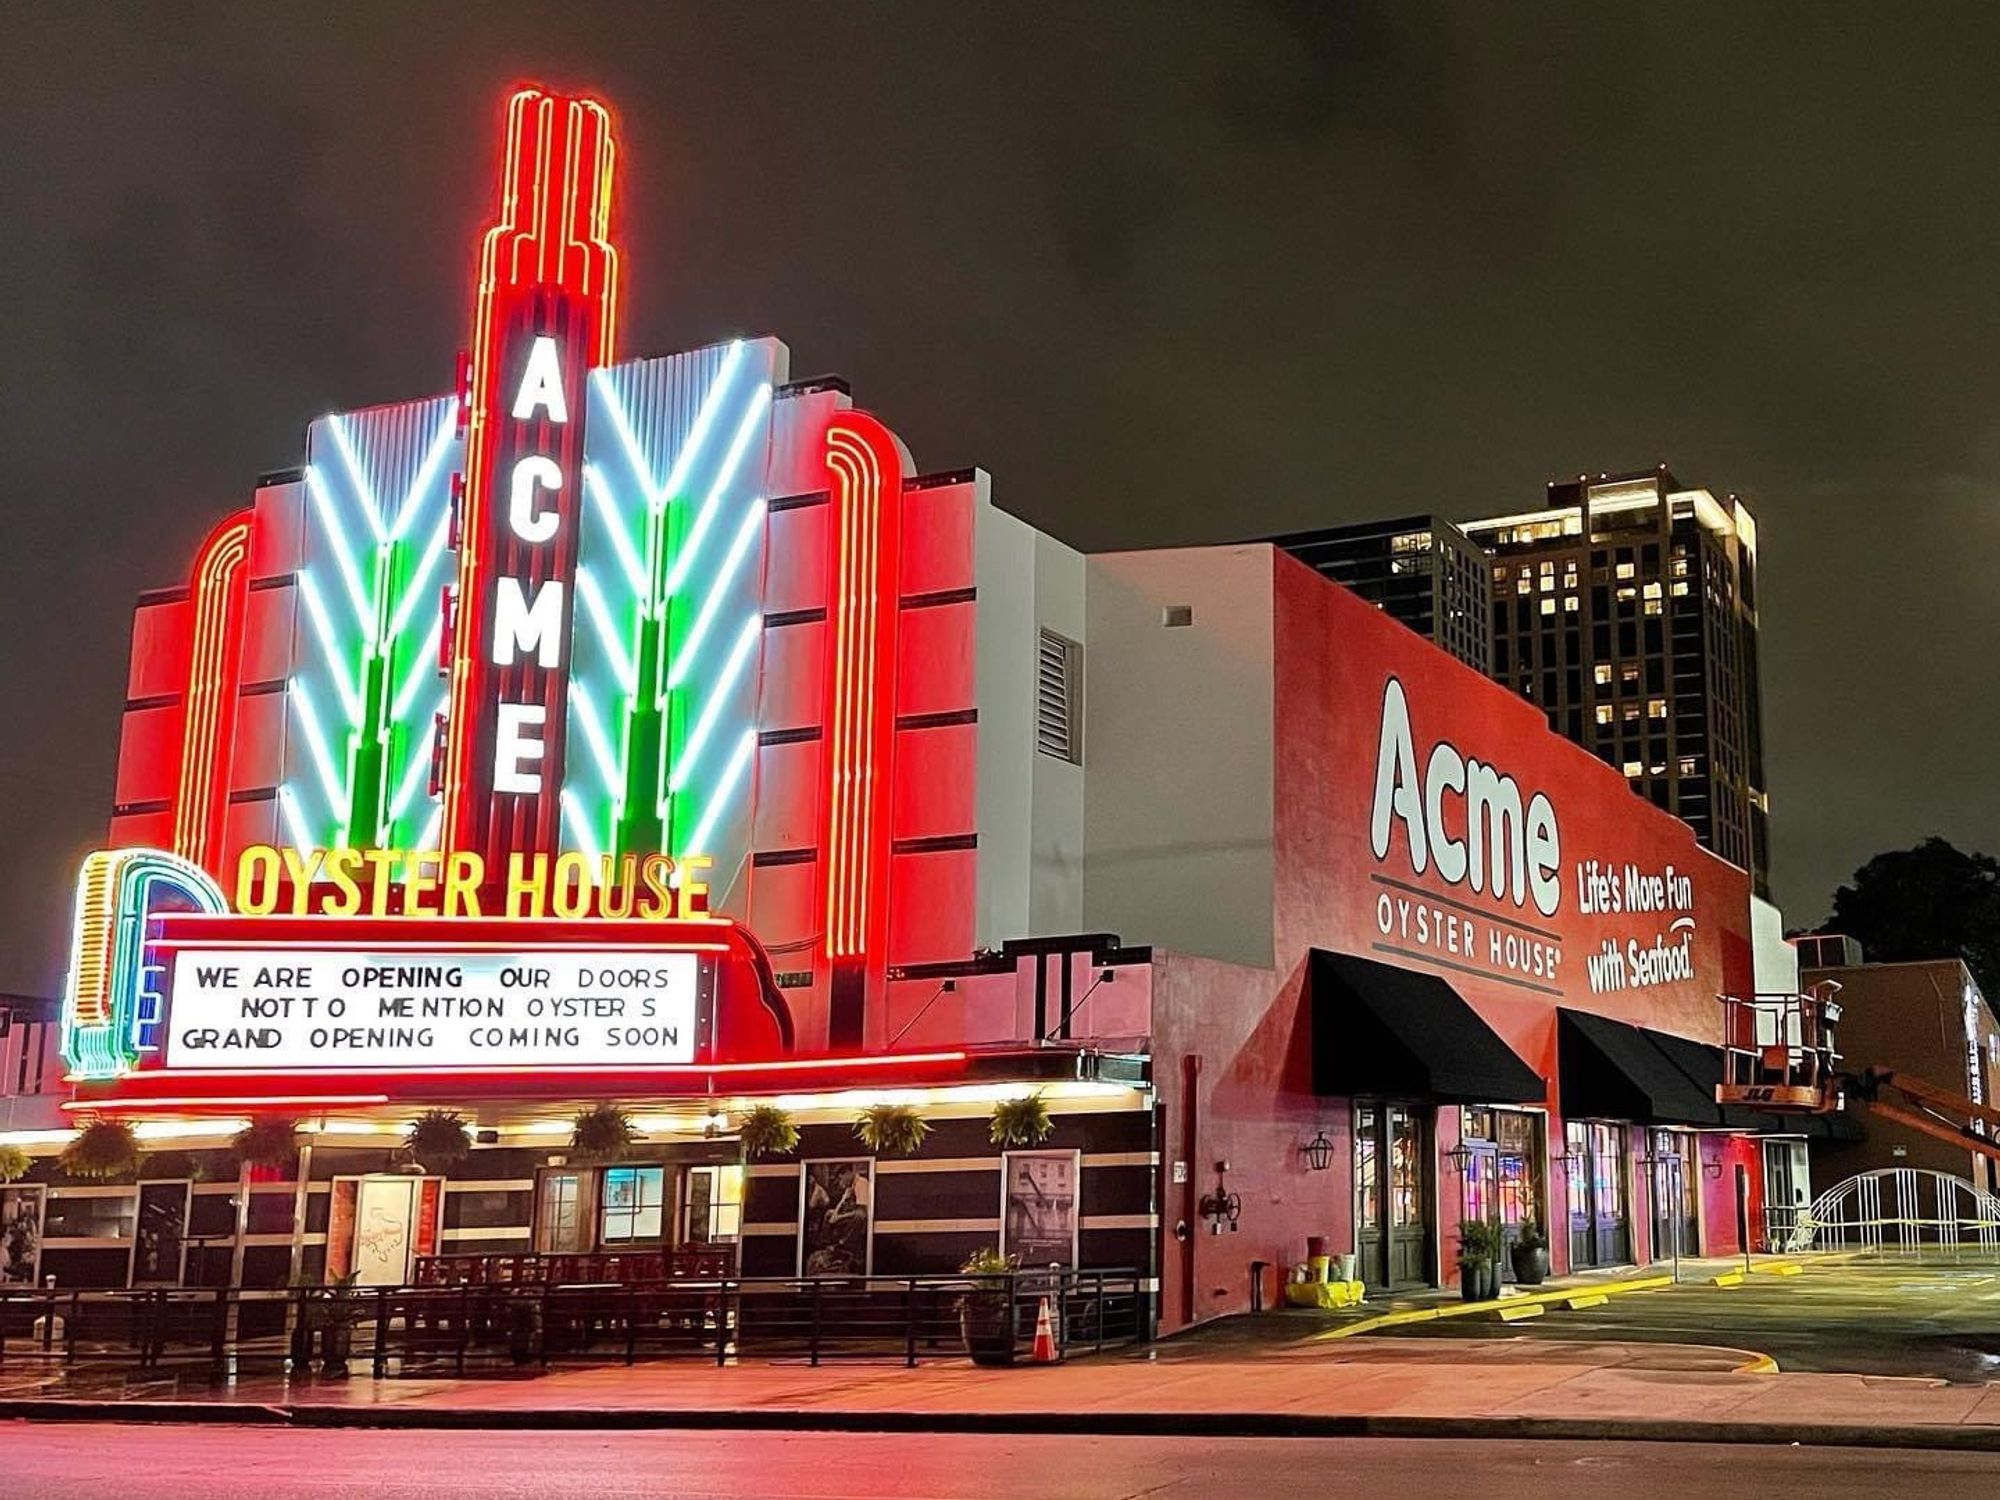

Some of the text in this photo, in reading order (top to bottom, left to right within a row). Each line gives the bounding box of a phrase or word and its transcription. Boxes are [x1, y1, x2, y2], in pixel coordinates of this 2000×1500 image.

[493, 335, 568, 795] ACME
[1371, 674, 1560, 917] Acme
[236, 844, 713, 919] OYSTER HOUSE
[1577, 859, 1693, 914] Life's More Fun
[1377, 893, 1475, 958] OYSTER
[196, 967, 669, 989] WE ARE OPENING OUR DOORS
[1587, 937, 1627, 994] with
[379, 997, 504, 1018] MENTION
[182, 1026, 679, 1049] GRAND OPENING COMING SOON
